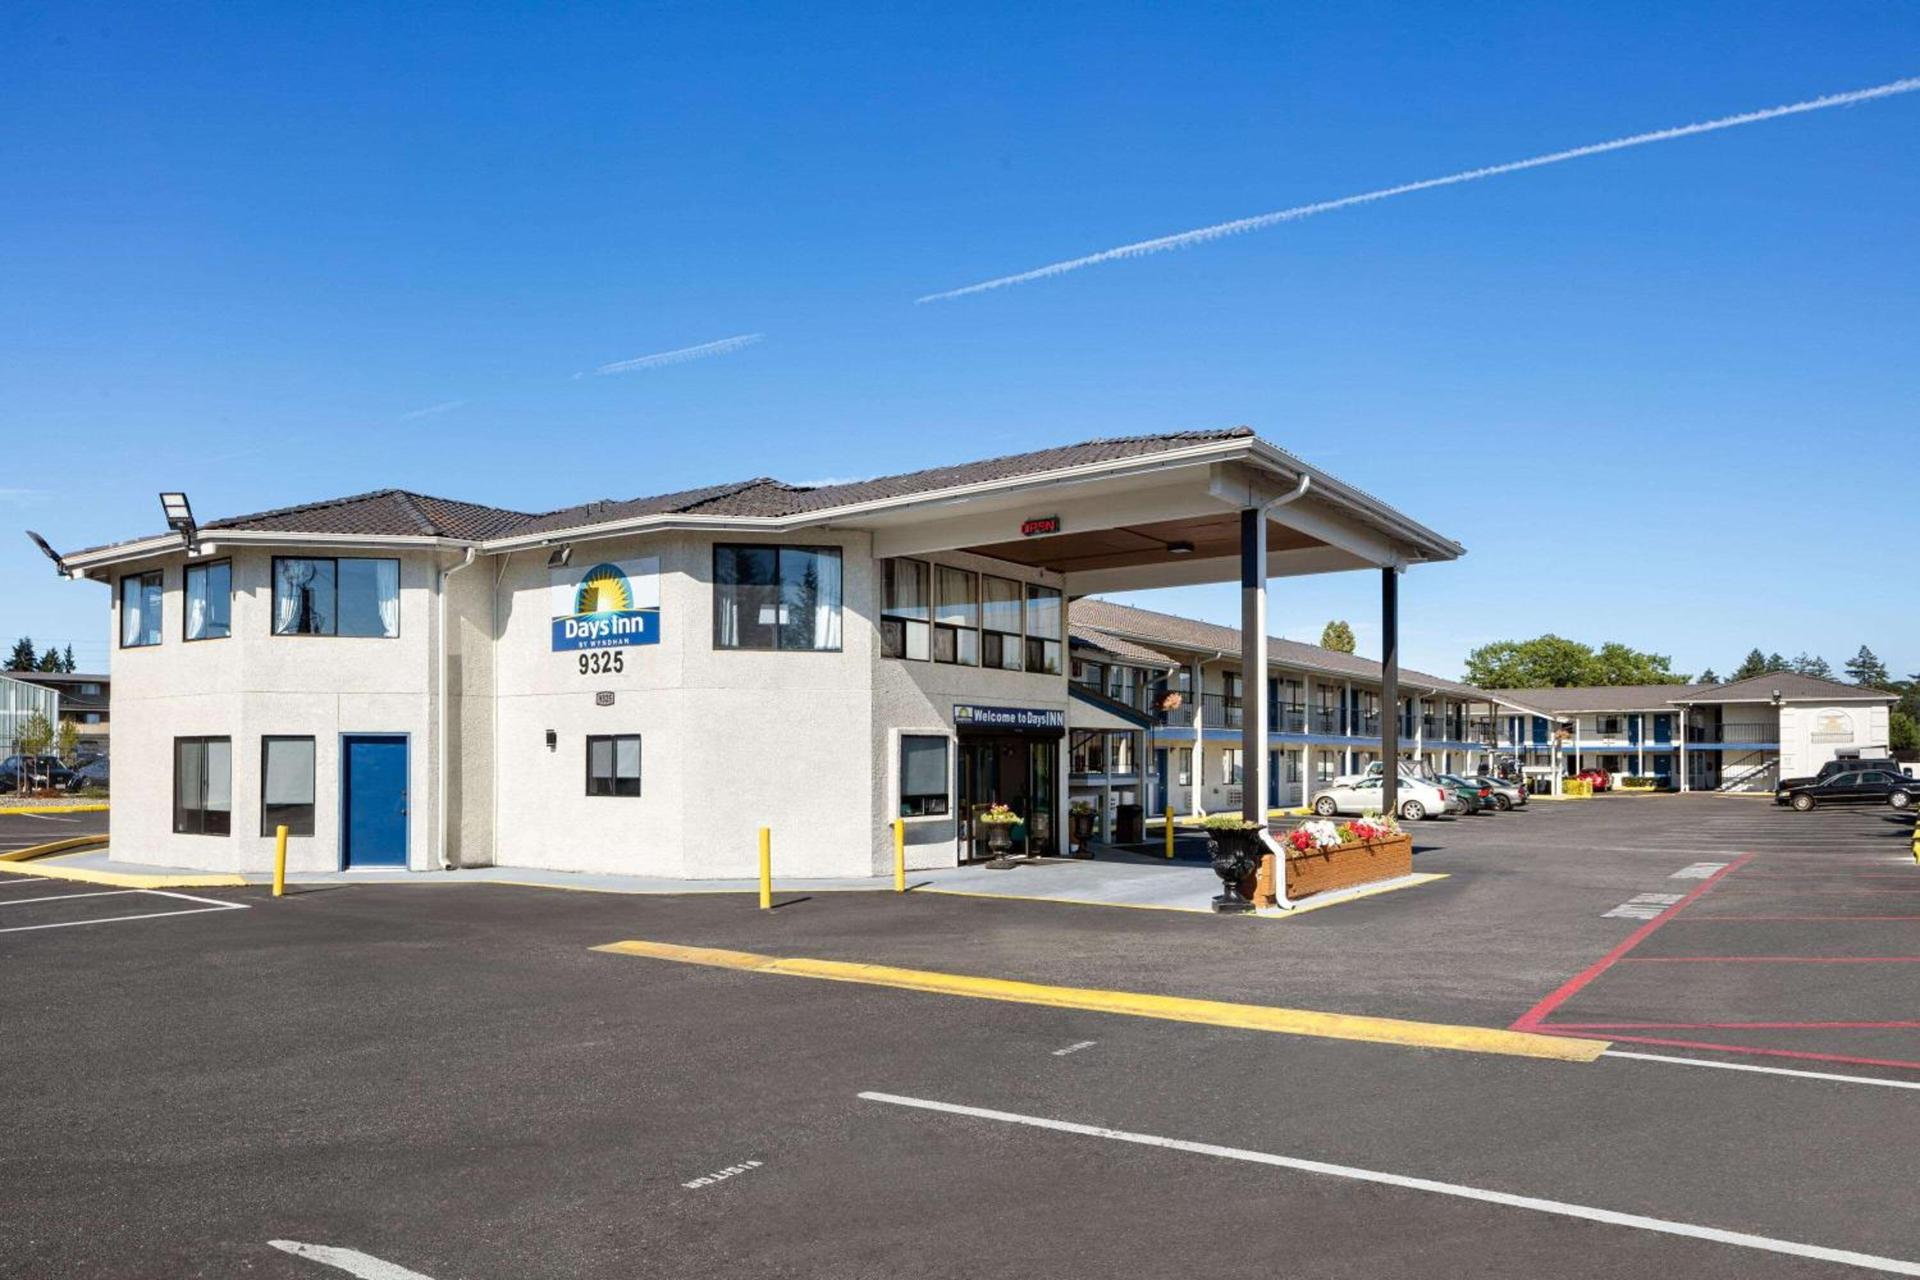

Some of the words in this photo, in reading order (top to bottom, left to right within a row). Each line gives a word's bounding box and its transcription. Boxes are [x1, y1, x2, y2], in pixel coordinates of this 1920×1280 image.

[565, 619, 609, 639] Days
[612, 614, 644, 635] Inn
[578, 650, 624, 675] 9325
[974, 709, 1016, 724] Welcome
[1018, 713, 1026, 724] to
